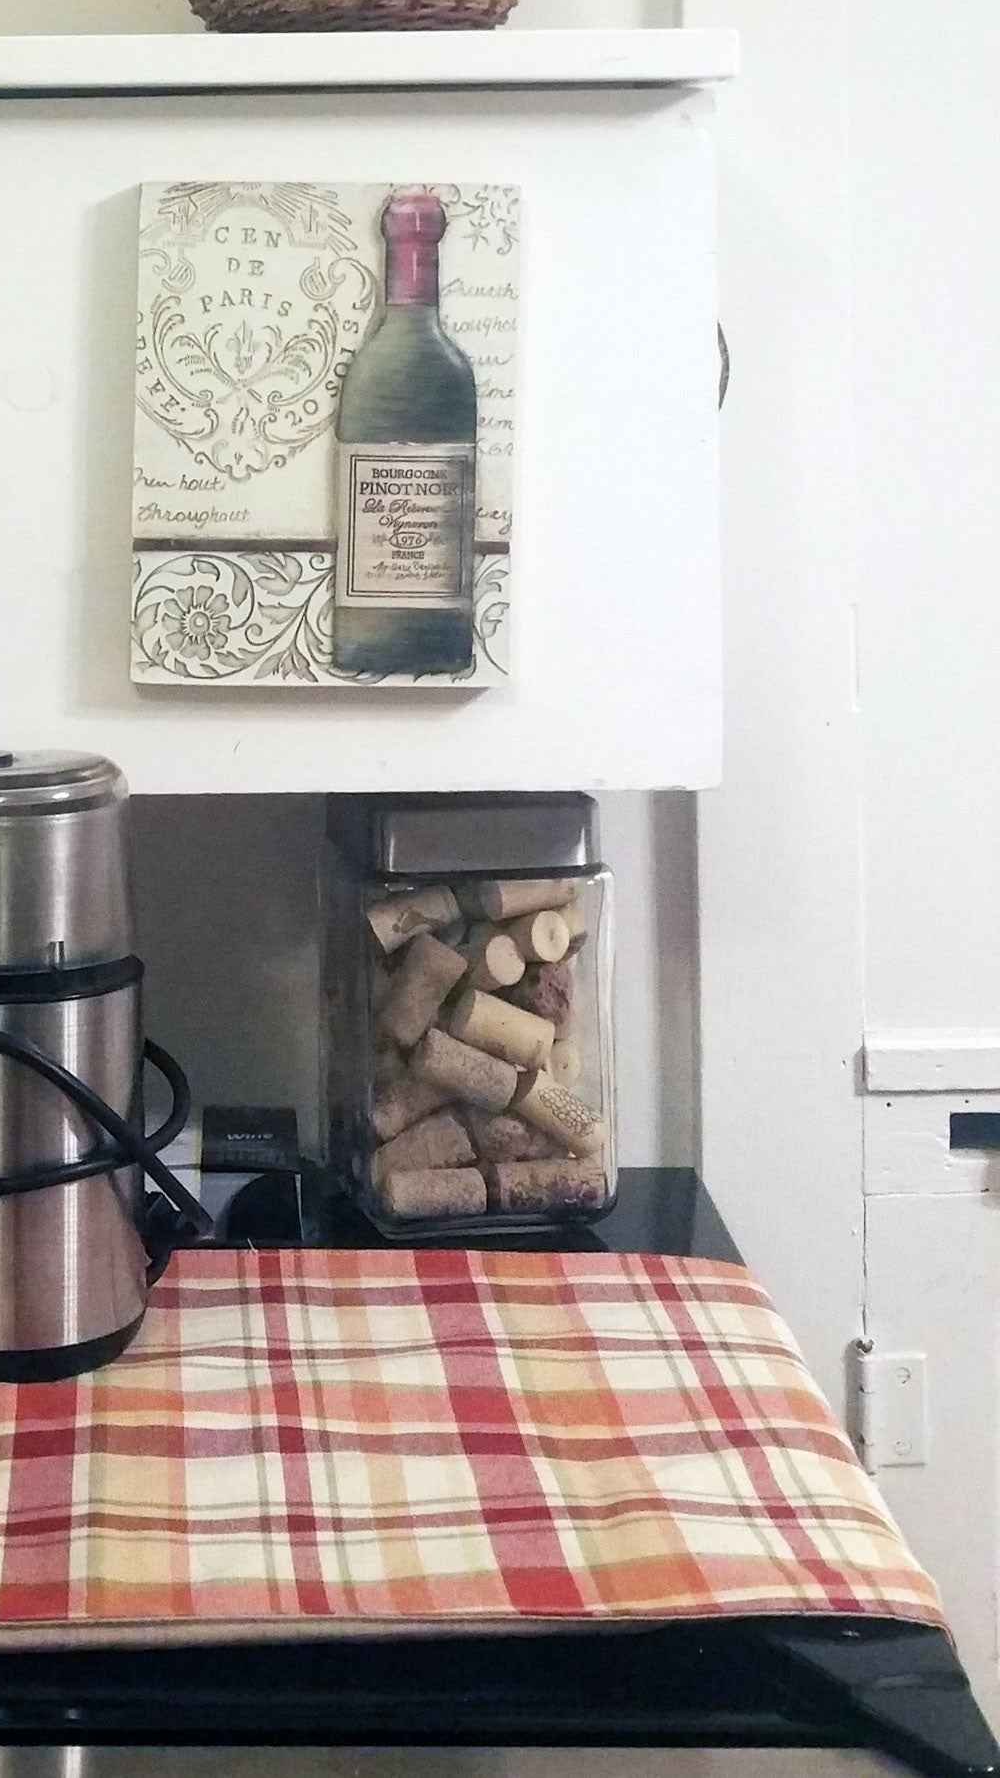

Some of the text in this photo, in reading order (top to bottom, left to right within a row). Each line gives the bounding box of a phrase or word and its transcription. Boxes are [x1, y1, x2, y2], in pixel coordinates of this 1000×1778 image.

[227, 257, 265, 277] DE
[199, 288, 293, 318] PARIS
[359, 481, 458, 496] PINOT NOIR
[394, 536, 423, 547] 1976
